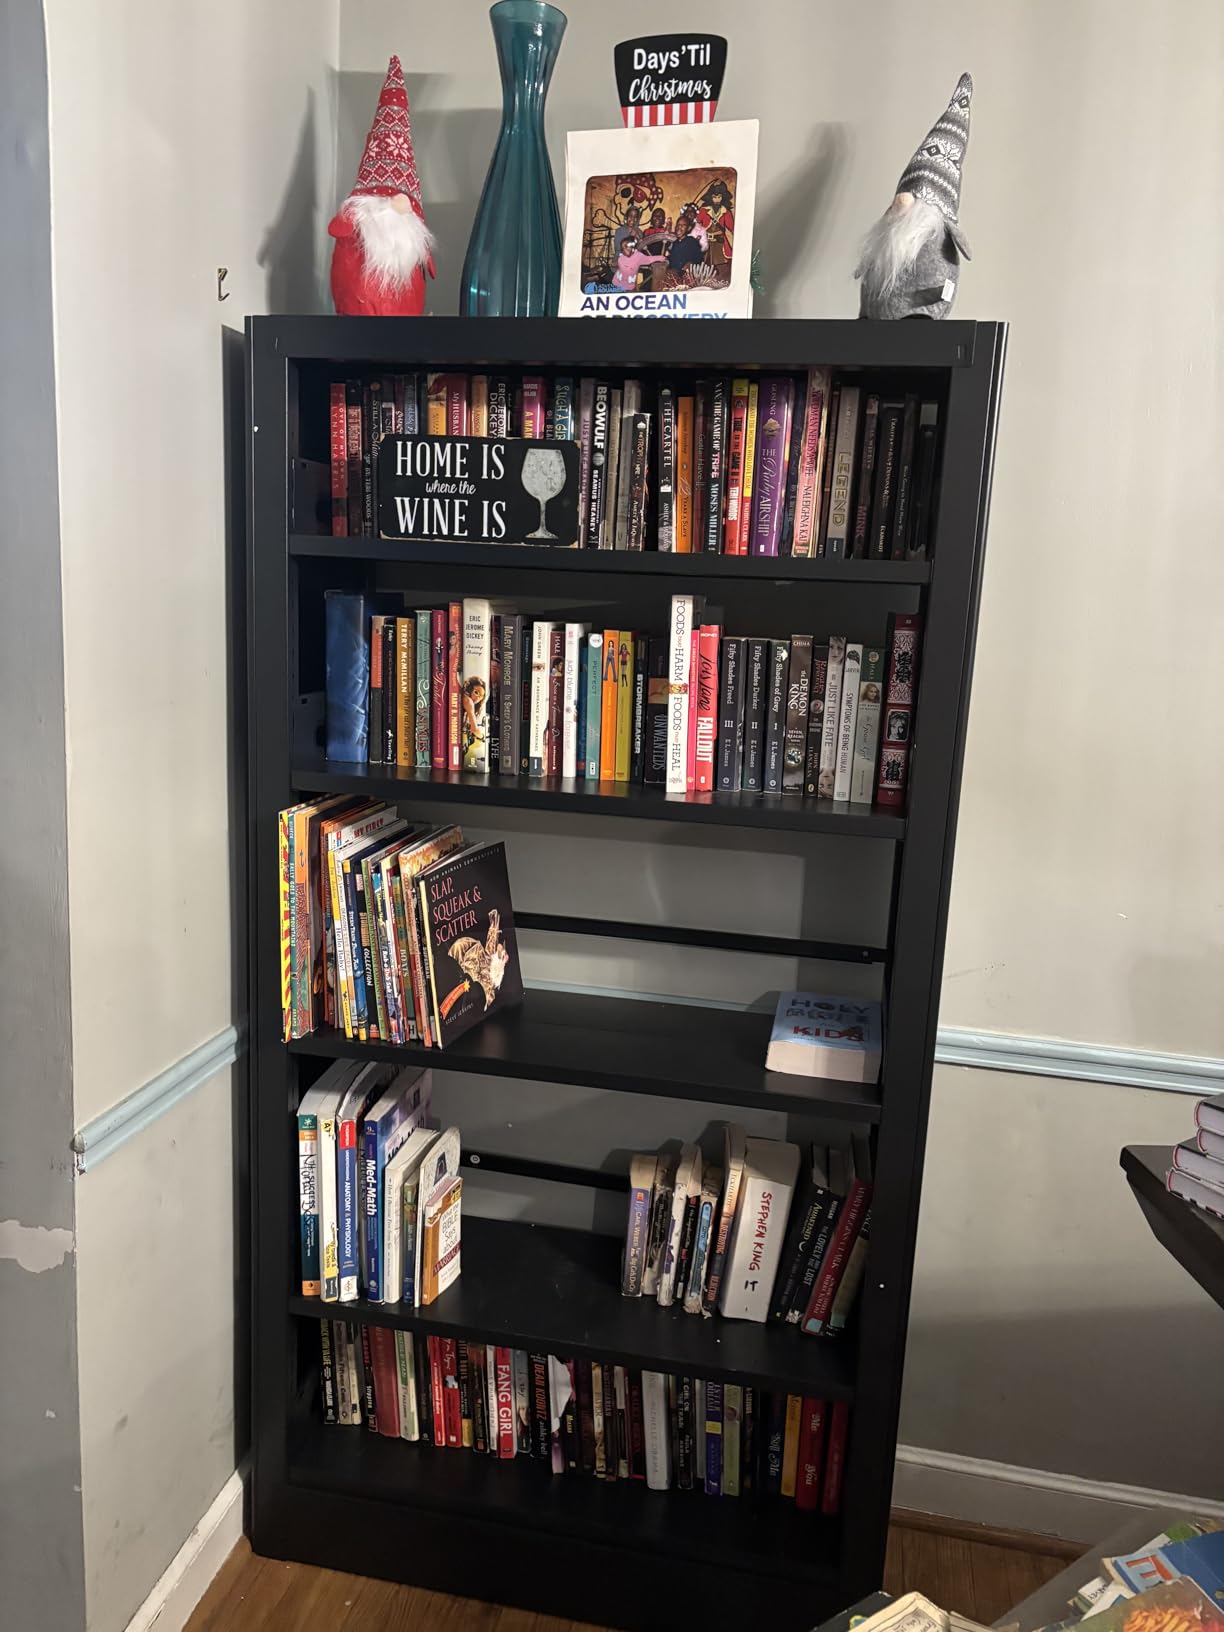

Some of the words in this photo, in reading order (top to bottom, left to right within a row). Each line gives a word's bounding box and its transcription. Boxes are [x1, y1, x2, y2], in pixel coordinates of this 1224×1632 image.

[633, 47, 680, 74] Days
[629, 74, 712, 103] Christmas
[580, 296, 610, 311] AN
[615, 294, 687, 310] OCEAN
[498, 383, 506, 402] ERIC
[555, 385, 570, 412] SUCH
[489, 392, 499, 436] DICKEY
[594, 386, 608, 449] BEOWULF
[555, 424, 569, 440] GIR
[712, 417, 722, 440] GAME
[663, 424, 672, 467] CARTEL
[395, 441, 469, 478] HOME
[481, 444, 505, 480] IS
[425, 479, 457, 494] where
[458, 480, 477, 495] the
[592, 469, 600, 499] SEAMUS
[709, 483, 719, 512] MOSES
[832, 452, 851, 527] LEGEND
[394, 496, 469, 537] WINE
[481, 500, 506, 538] IS
[589, 502, 599, 533] HEANEY
[707, 514, 718, 546] MILLER
[756, 495, 773, 538] AIRSHIP
[675, 599, 686, 635] FOODS
[466, 632, 484, 640] DICKEY
[503, 625, 514, 648] MARY
[553, 635, 561, 654] HALE
[673, 648, 685, 682] HARM
[754, 645, 763, 662] Fifty
[503, 651, 513, 685] MONROE
[565, 660, 576, 676] judy
[727, 661, 736, 684] Shades
[752, 662, 761, 686] Shades
[773, 663, 783, 687] Shades
[726, 685, 735, 705] Freed
[751, 686, 760, 710] Darker
[771, 697, 781, 713] Grey
[787, 683, 799, 710] KING
[798, 678, 810, 717] DEMON
[829, 683, 838, 704] JUST
[633, 673, 644, 755] STORMBREAKER
[672, 696, 683, 731] FOODS
[827, 706, 837, 726] LIKE
[842, 692, 854, 724] SYMPTOMS
[652, 713, 669, 771] UNWANTEDS
[696, 716, 714, 763] FALLOUT
[825, 727, 835, 747] FATE
[841, 733, 851, 751] BEING
[843, 724, 851, 733] OF
[490, 737, 500, 758] LYFE
[671, 743, 682, 772] HEAL
[770, 750, 778, 770] James
[840, 751, 849, 774] HUMAN
[430, 876, 454, 903] SLAP,
[432, 889, 473, 925] SQUEAK
[473, 885, 482, 903] &
[435, 909, 478, 946] SCATTER
[363, 947, 374, 987] COLLECTION
[400, 949, 409, 977] BOATS
[792, 1025, 865, 1042] KIDS
[366, 1159, 377, 1216] Med-Math
[754, 1191, 773, 1238] STEPHEN
[801, 1202, 823, 1241] AWAKENED
[345, 1218, 353, 1258] PHYSIOLOGY
[811, 1233, 828, 1259] LOVELY
[748, 1241, 764, 1272] KING
[801, 1267, 818, 1287] LOST
[497, 1363, 511, 1403] FANG
[534, 1363, 546, 1387] DEAN
[535, 1387, 548, 1420] KOONTZ
[499, 1406, 513, 1437] GIRL
[804, 1463, 818, 1486] You
